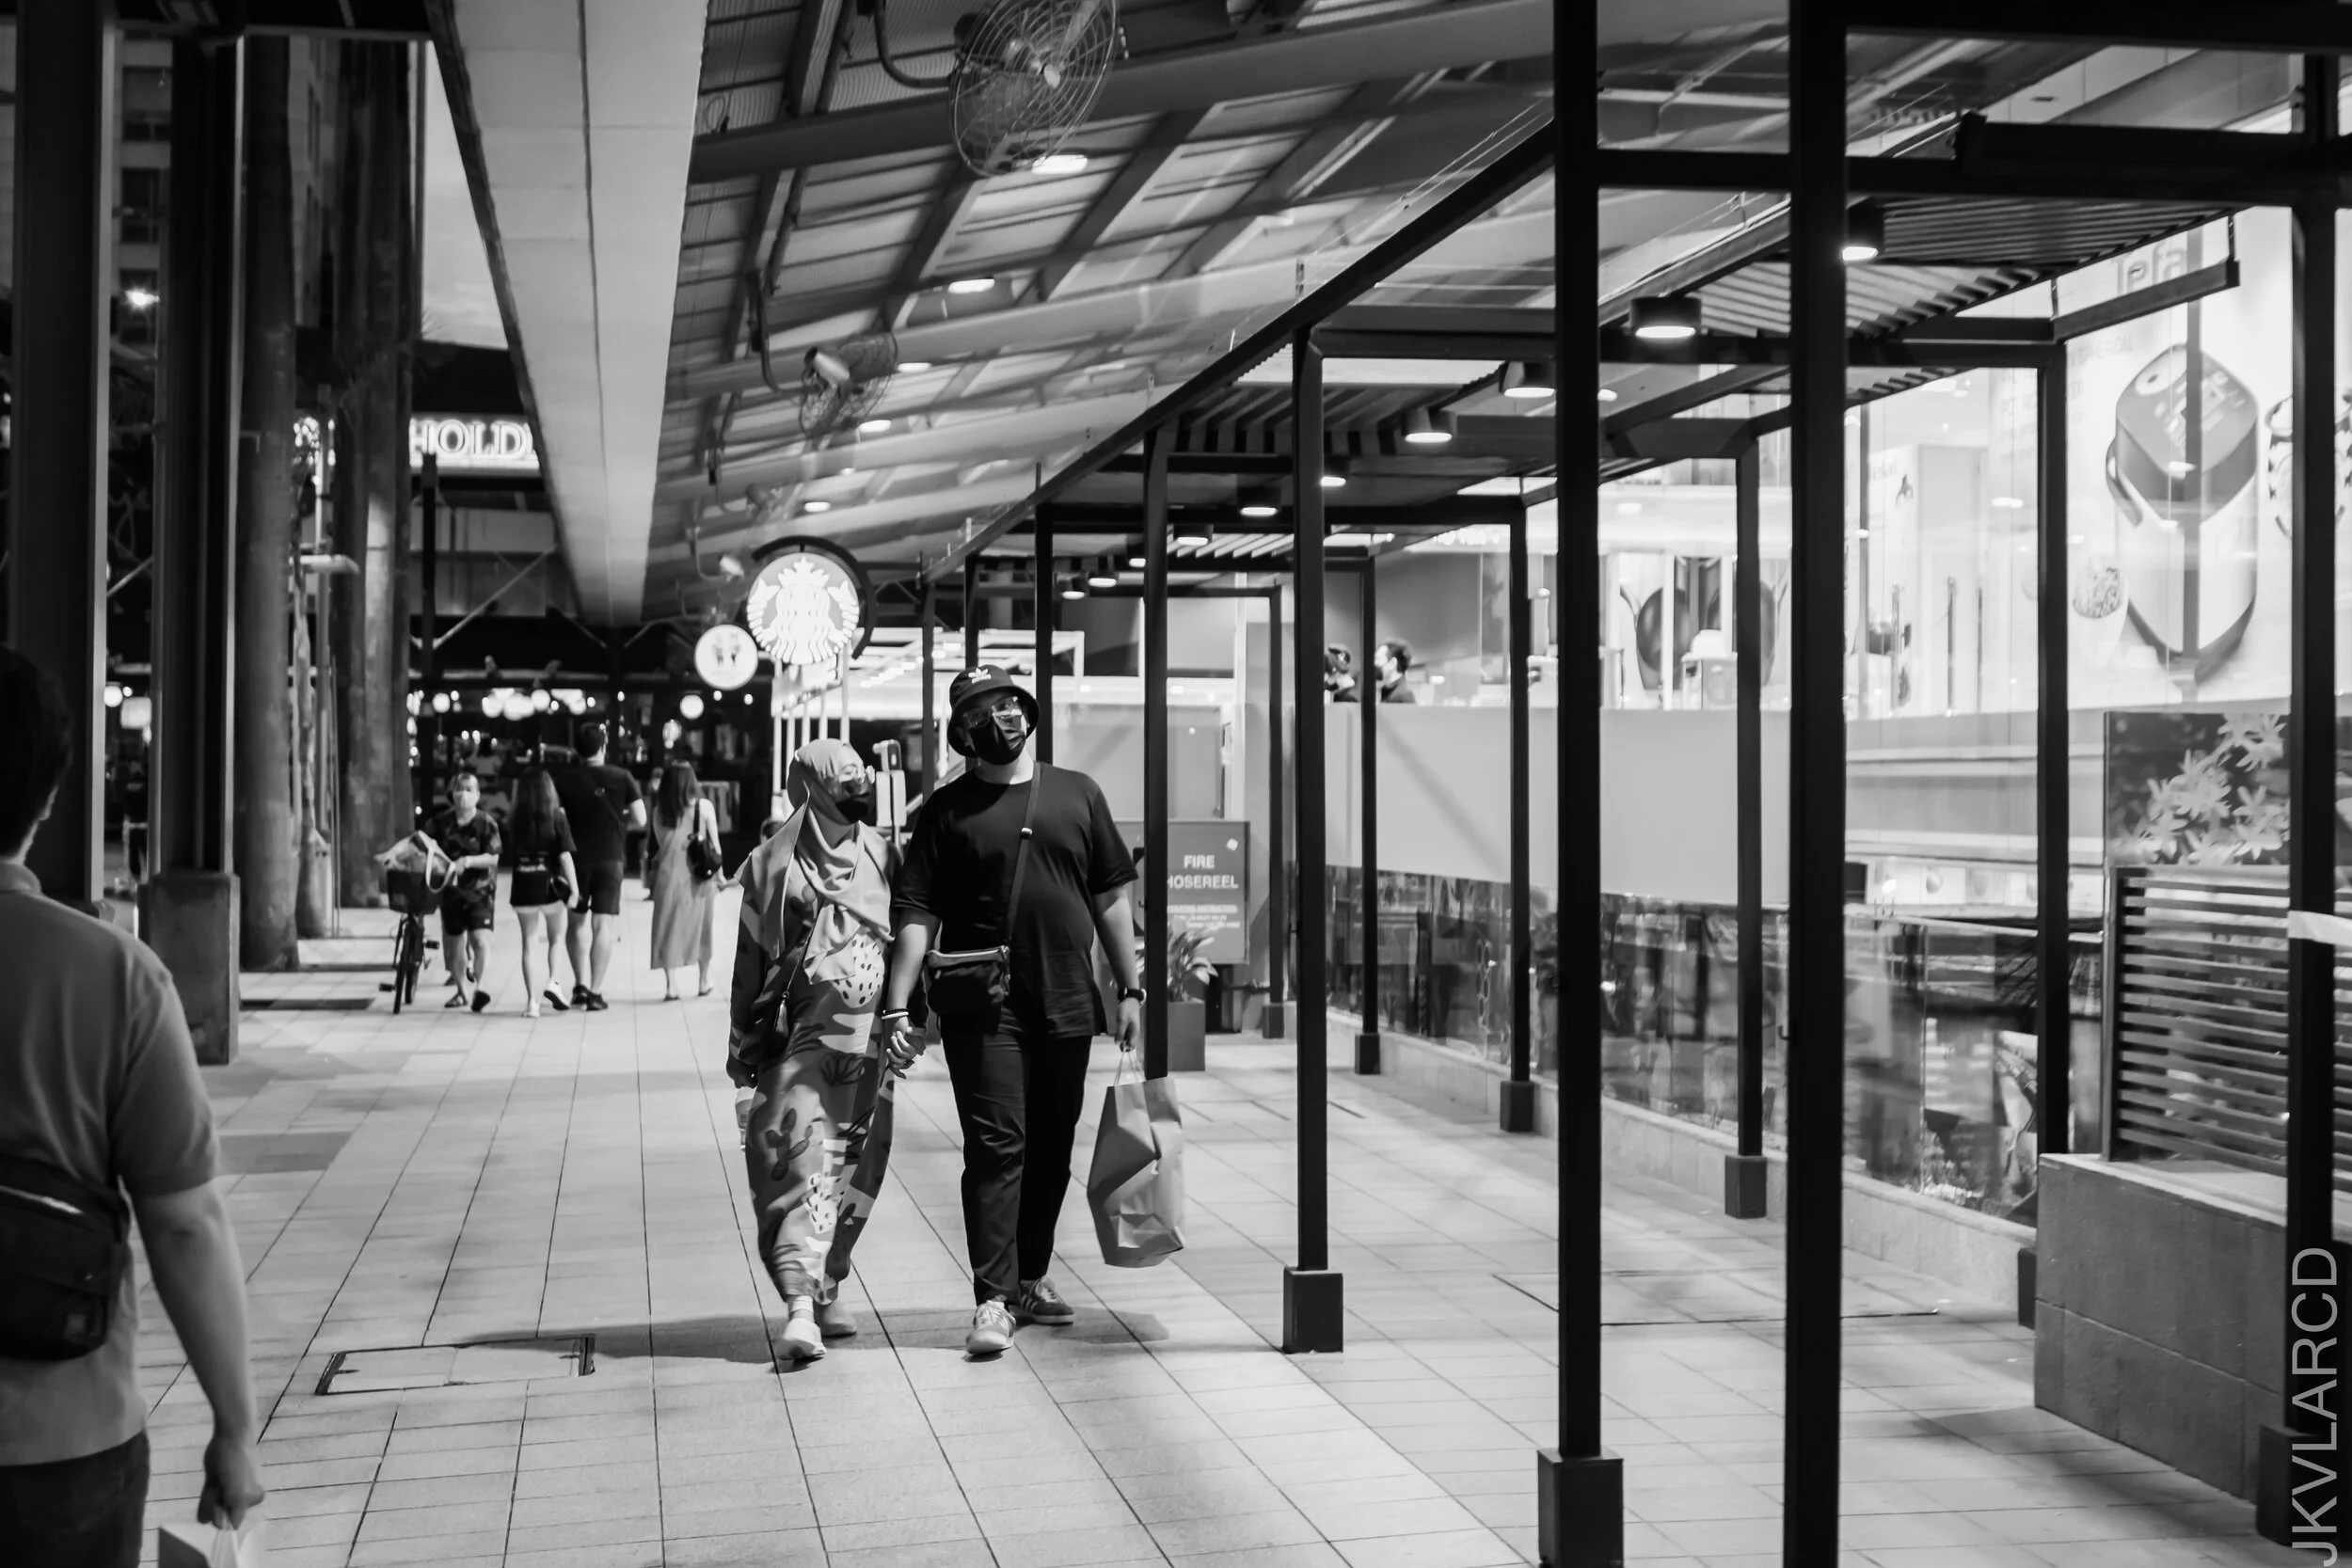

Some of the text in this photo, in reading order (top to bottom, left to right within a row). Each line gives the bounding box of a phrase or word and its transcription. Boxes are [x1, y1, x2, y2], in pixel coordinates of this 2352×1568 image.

[2113, 241, 2187, 295] Tefa
[408, 420, 533, 457] HOLD
[1184, 854, 1216, 869] FIRE
